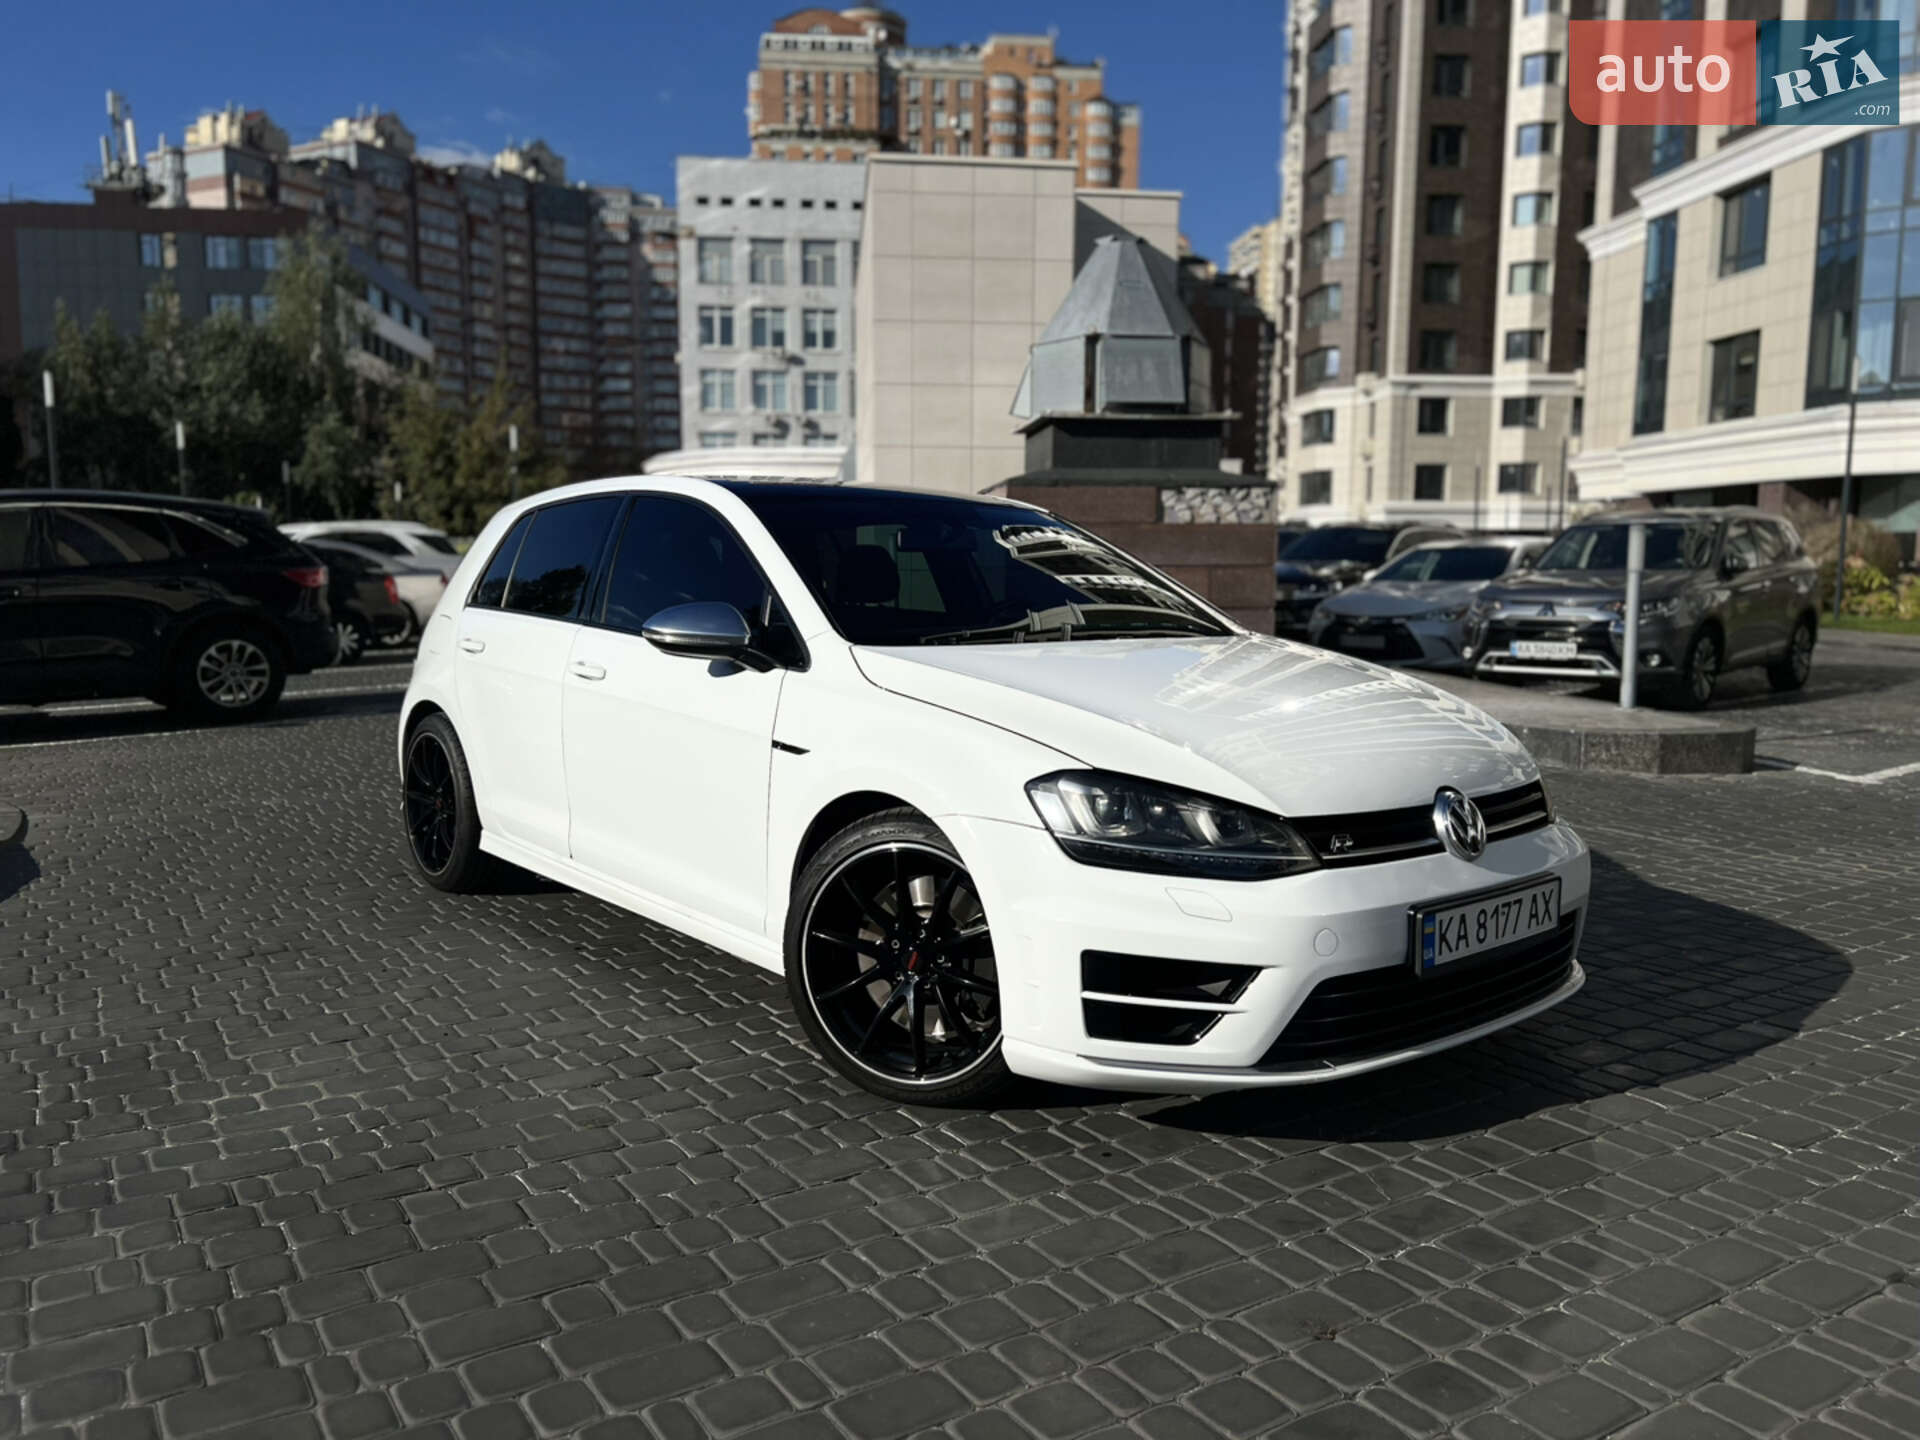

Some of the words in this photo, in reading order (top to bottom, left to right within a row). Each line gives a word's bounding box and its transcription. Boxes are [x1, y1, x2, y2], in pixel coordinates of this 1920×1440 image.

[1330, 833, 1354, 853] R
[1438, 913, 1470, 956] KA
[1476, 897, 1524, 944] 8177
[1528, 888, 1555, 929] AX
